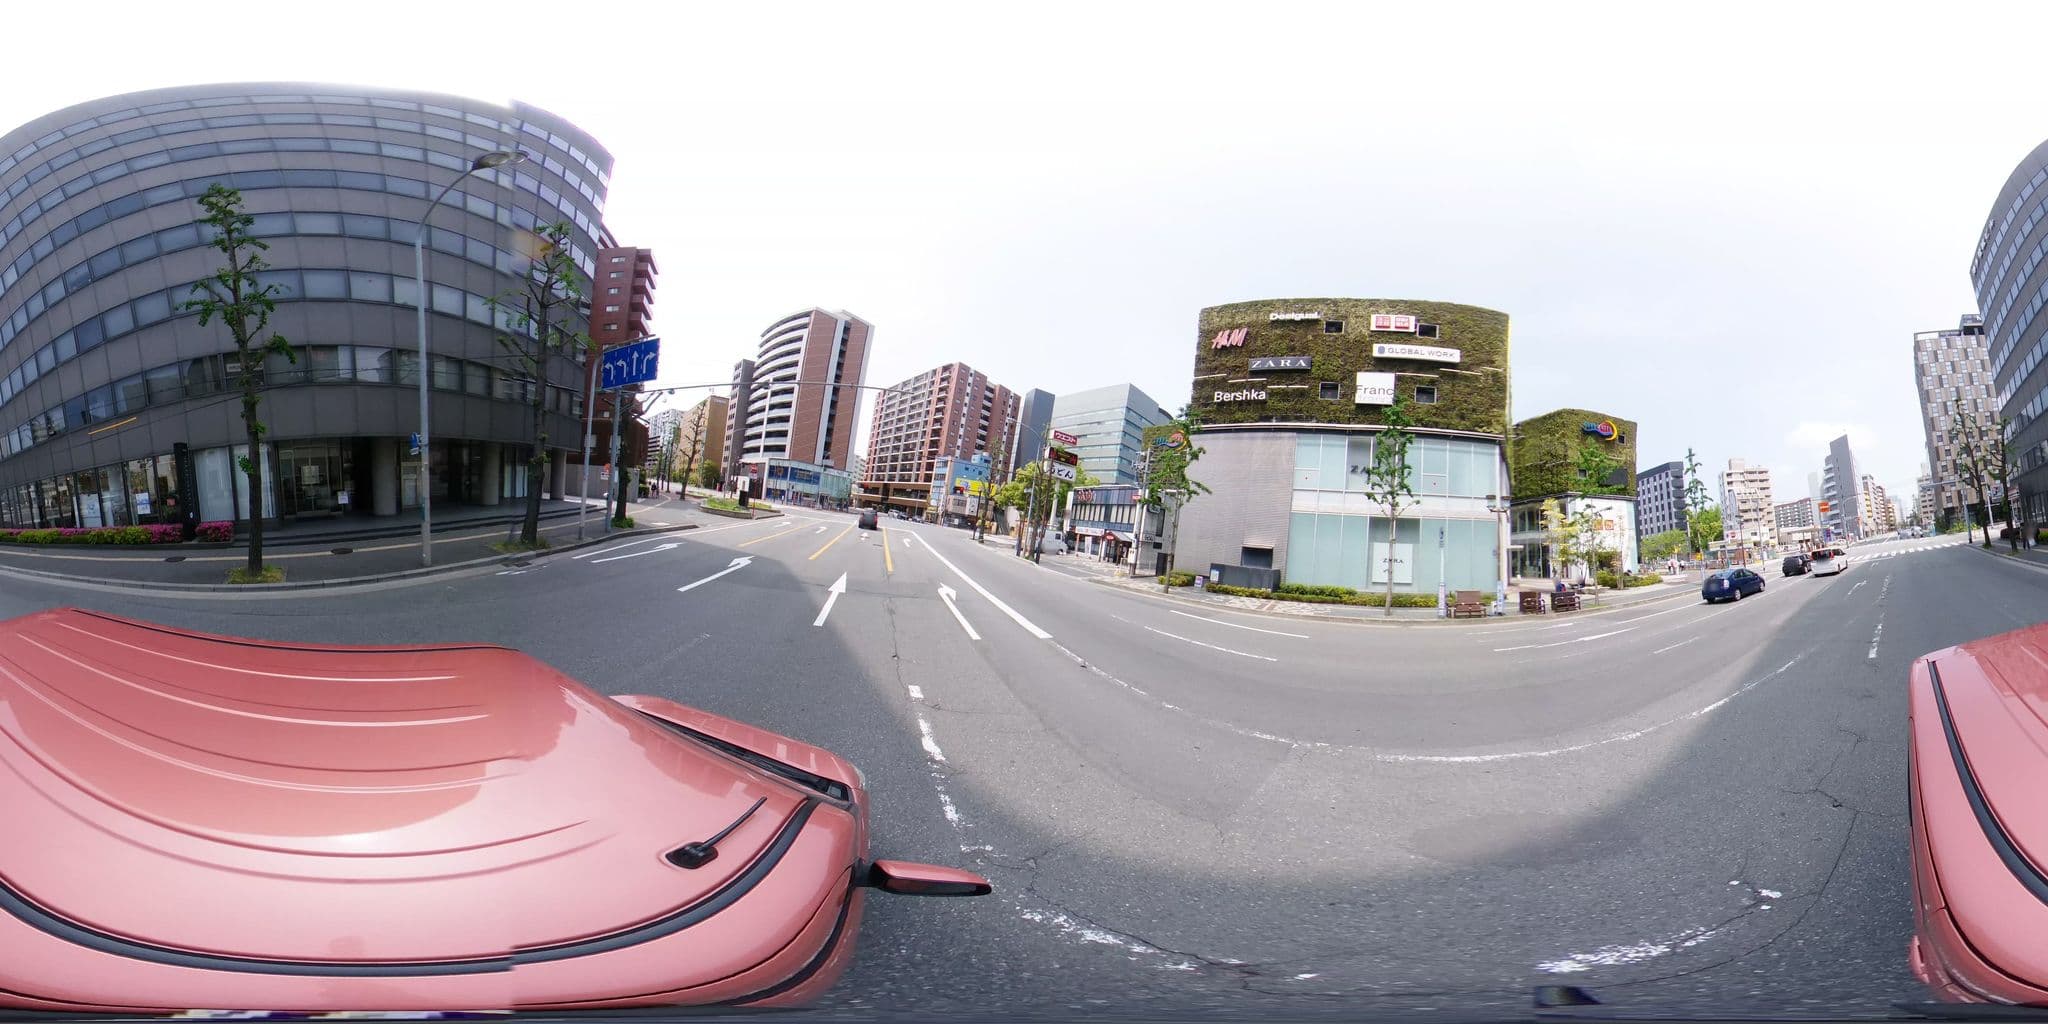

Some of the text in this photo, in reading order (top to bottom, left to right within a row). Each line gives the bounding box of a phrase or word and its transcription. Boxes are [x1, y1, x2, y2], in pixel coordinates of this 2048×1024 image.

[1211, 327, 1248, 349] H&M
[1387, 347, 1455, 358] GLOBAL WORK
[1251, 359, 1306, 368] ZARA
[1214, 389, 1266, 402] Bershka
[1356, 384, 1394, 396] Franc
